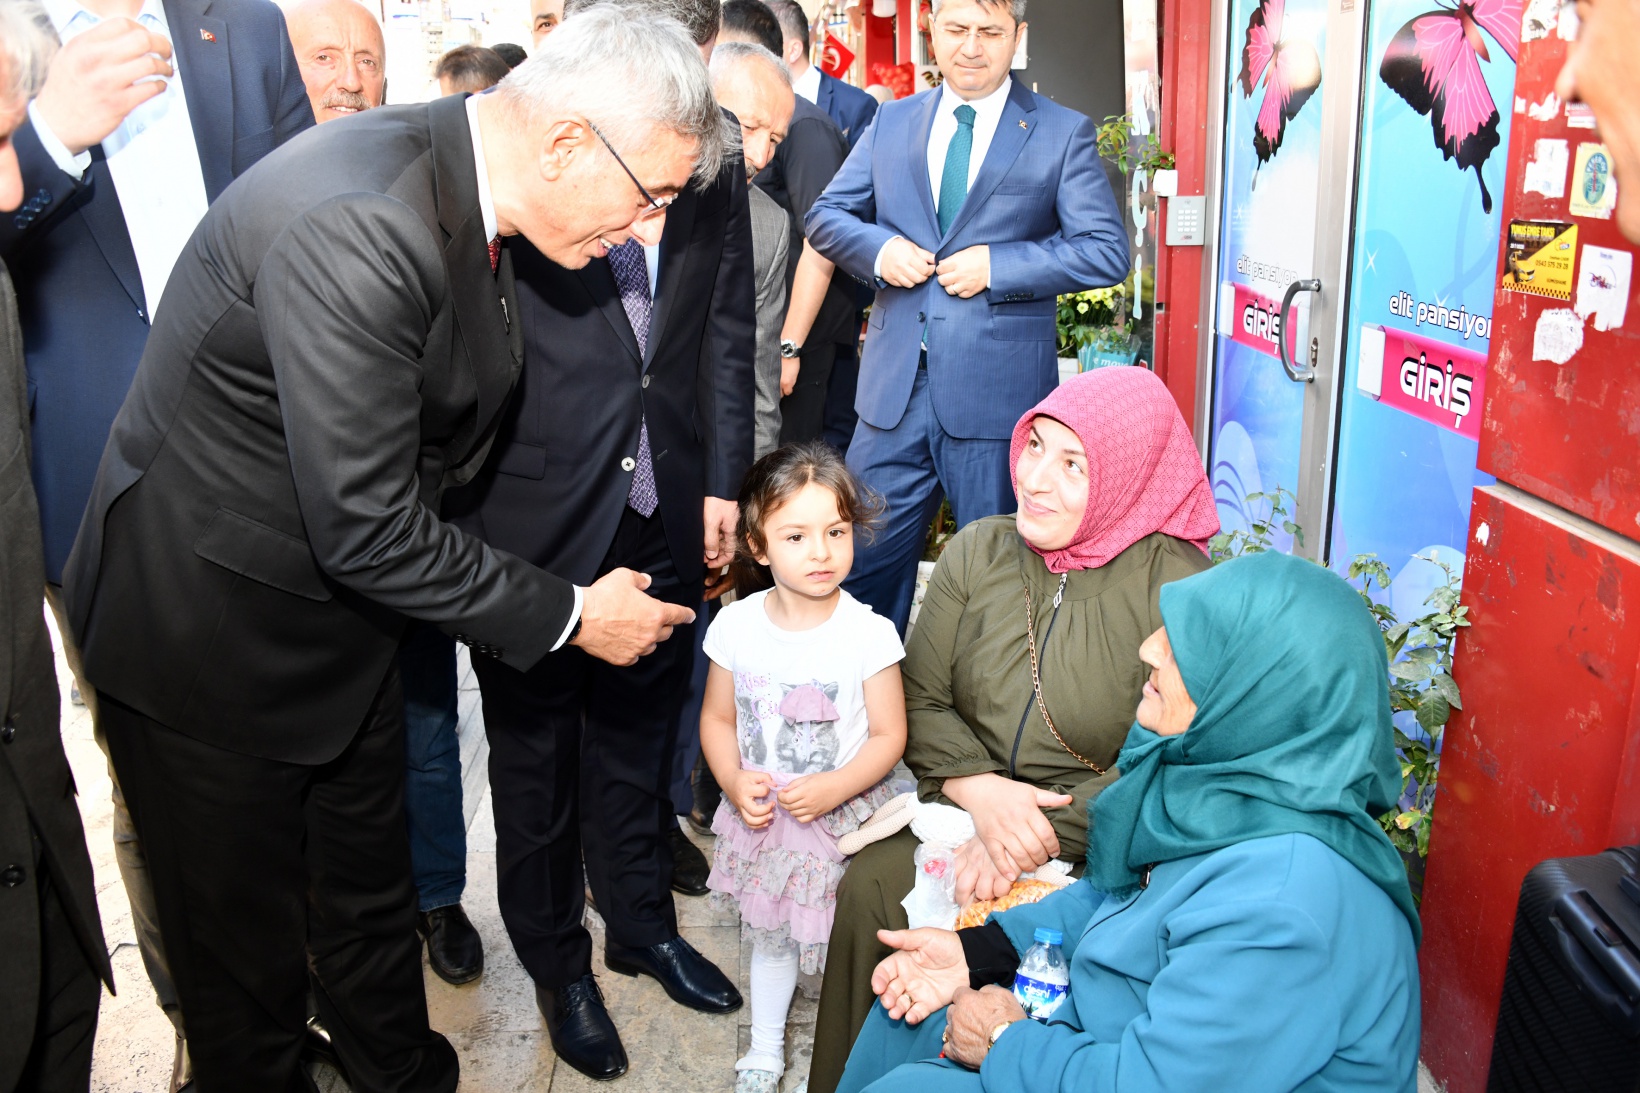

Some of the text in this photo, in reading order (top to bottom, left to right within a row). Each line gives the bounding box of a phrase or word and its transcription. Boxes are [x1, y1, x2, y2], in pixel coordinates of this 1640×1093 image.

[1237, 254, 1251, 276] elit
[1389, 290, 1414, 319] elit
[1400, 351, 1474, 429] GİRİŞ
